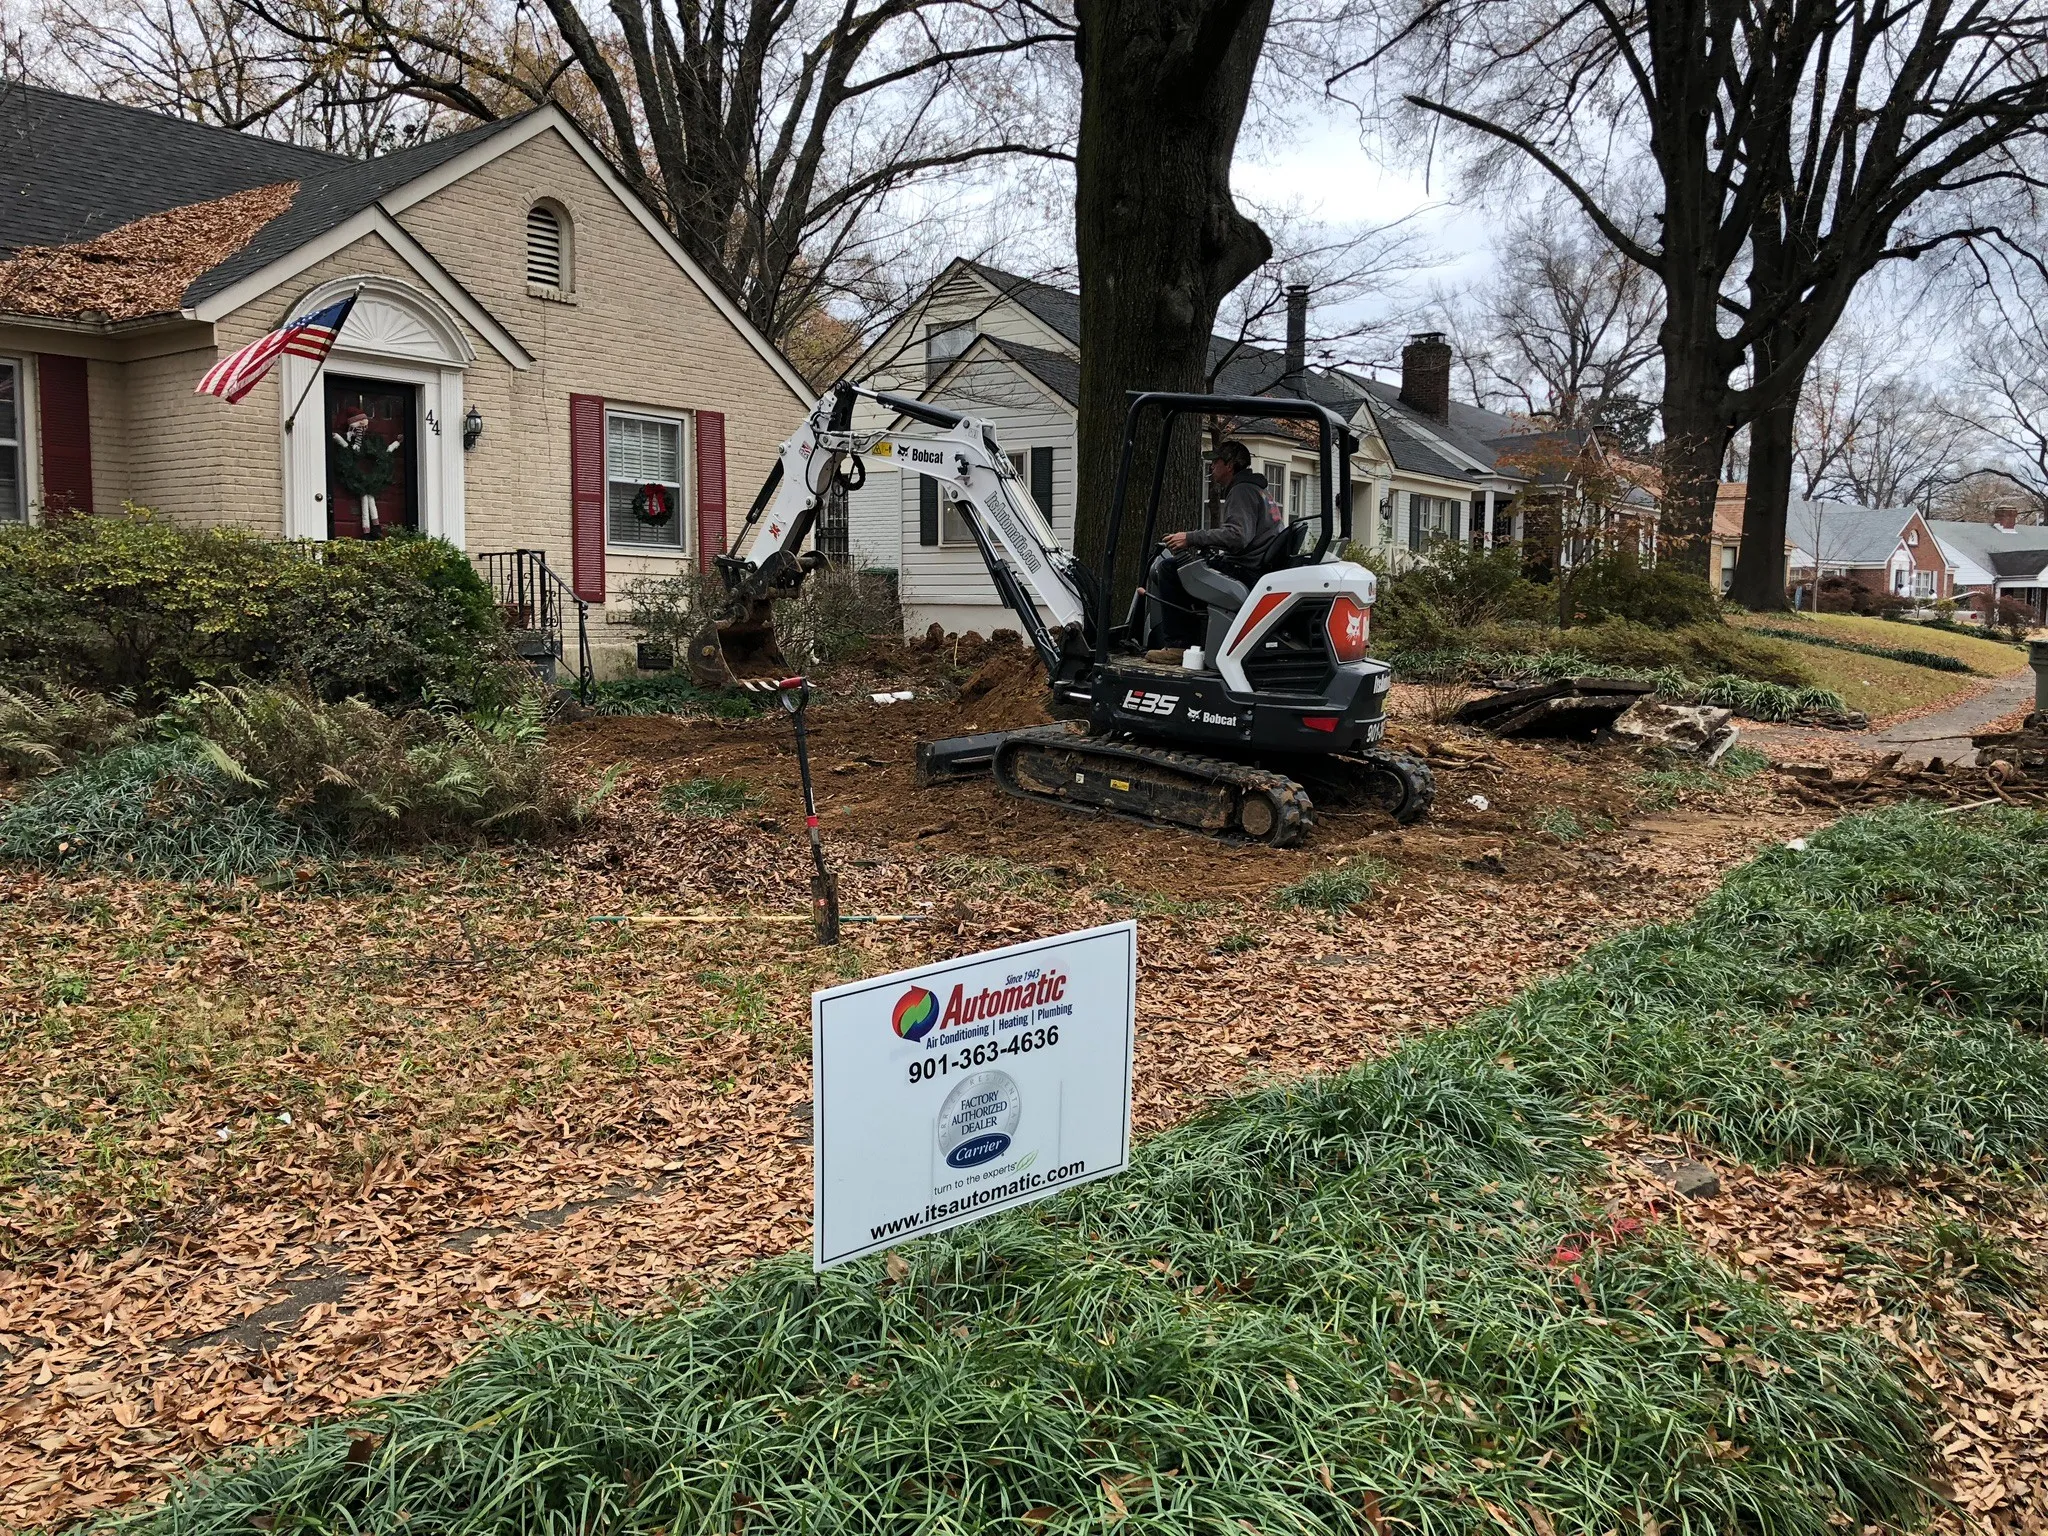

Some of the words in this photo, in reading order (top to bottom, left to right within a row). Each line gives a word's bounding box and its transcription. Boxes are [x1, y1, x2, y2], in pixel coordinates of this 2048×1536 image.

[425, 409, 441, 436] 44
[911, 448, 944, 465] Bobcat
[983, 490, 1042, 575] ItsAutomatic.com
[1121, 689, 1180, 716] E35
[1202, 711, 1237, 727] Bobcat
[1005, 971, 1023, 986] Since
[1023, 968, 1041, 982] 1943
[939, 969, 1067, 1030] Automatic
[926, 1036, 938, 1050] Air
[939, 1024, 989, 1046] Conditioning
[999, 1014, 1028, 1031] Heating
[1037, 1003, 1073, 1021] Plumbing
[908, 1025, 1059, 1084] 901-363-4636
[951, 1100, 1008, 1126] AUTHORIZED
[961, 1090, 1000, 1110] FACTORY
[961, 1115, 998, 1135] DEALER
[956, 1140, 1002, 1161] Carrier
[934, 1183, 952, 1195] turn
[954, 1179, 964, 1189] to
[966, 1174, 981, 1185] the
[870, 1160, 1085, 1240] www.itsautomatic.com
